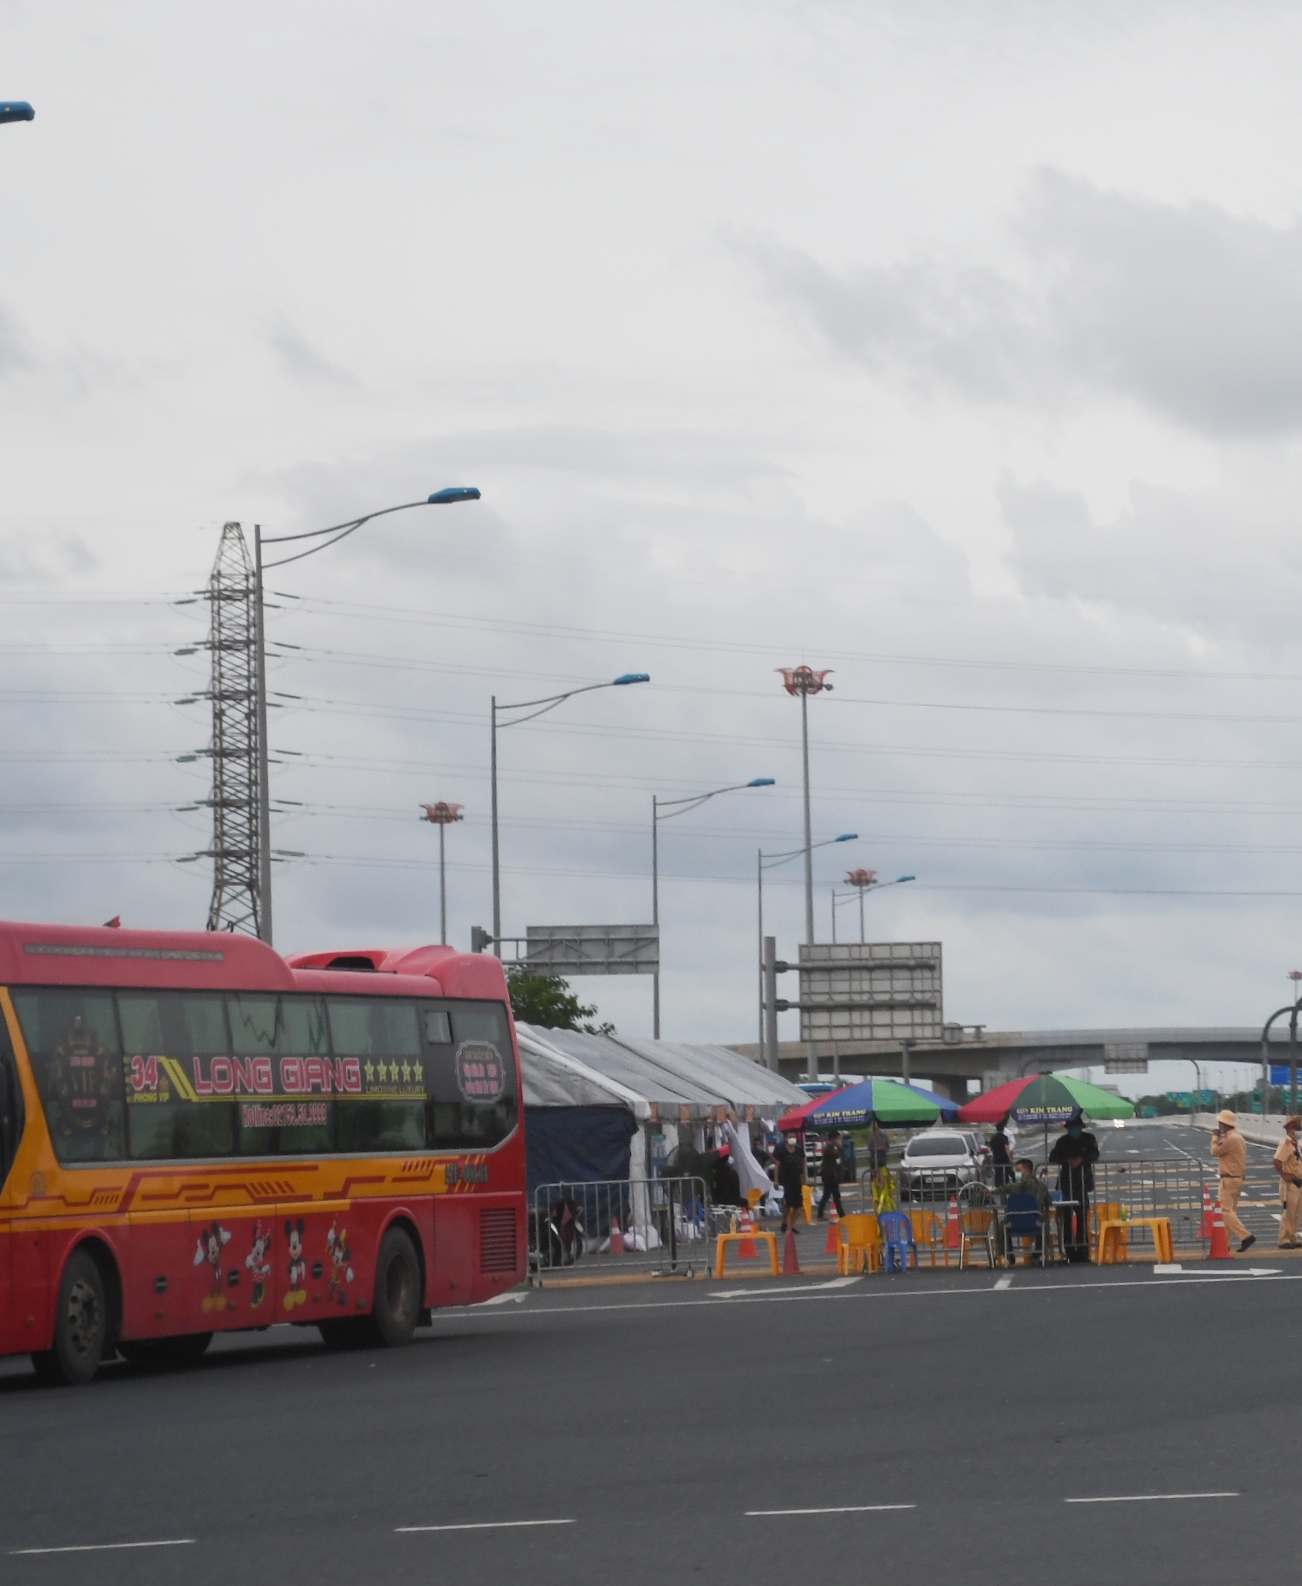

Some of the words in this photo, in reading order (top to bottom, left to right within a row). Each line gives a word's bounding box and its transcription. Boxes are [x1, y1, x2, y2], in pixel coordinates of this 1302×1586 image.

[131, 1055, 158, 1091] 34
[193, 1056, 273, 1093] LONG
[280, 1056, 362, 1092] GIANG
[1046, 1106, 1073, 1114] TRANG
